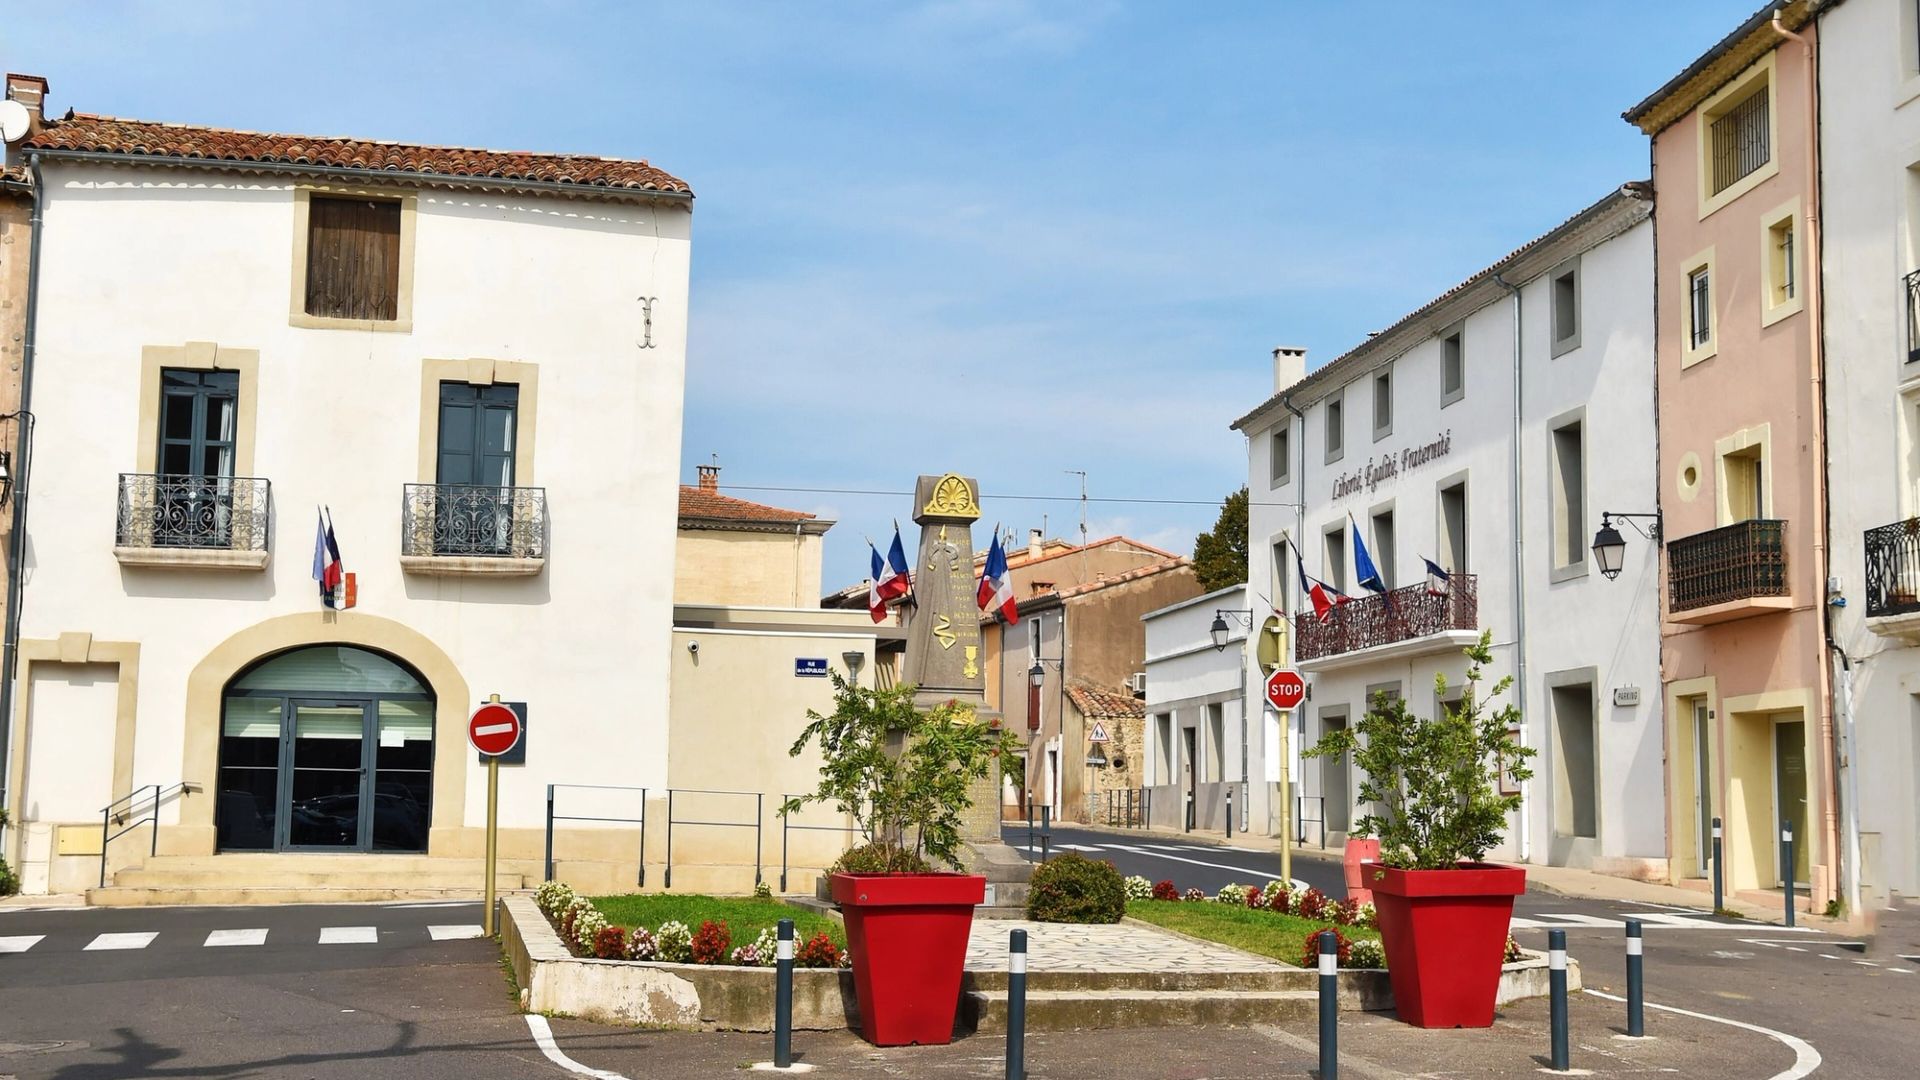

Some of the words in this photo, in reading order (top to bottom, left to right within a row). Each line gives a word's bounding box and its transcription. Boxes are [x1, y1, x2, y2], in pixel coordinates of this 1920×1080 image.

[1331, 467, 1363, 500] Liberté,
[1400, 428, 1451, 472] Fraternité
[1271, 684, 1302, 696] STOP
[1618, 691, 1638, 700] PARKING
